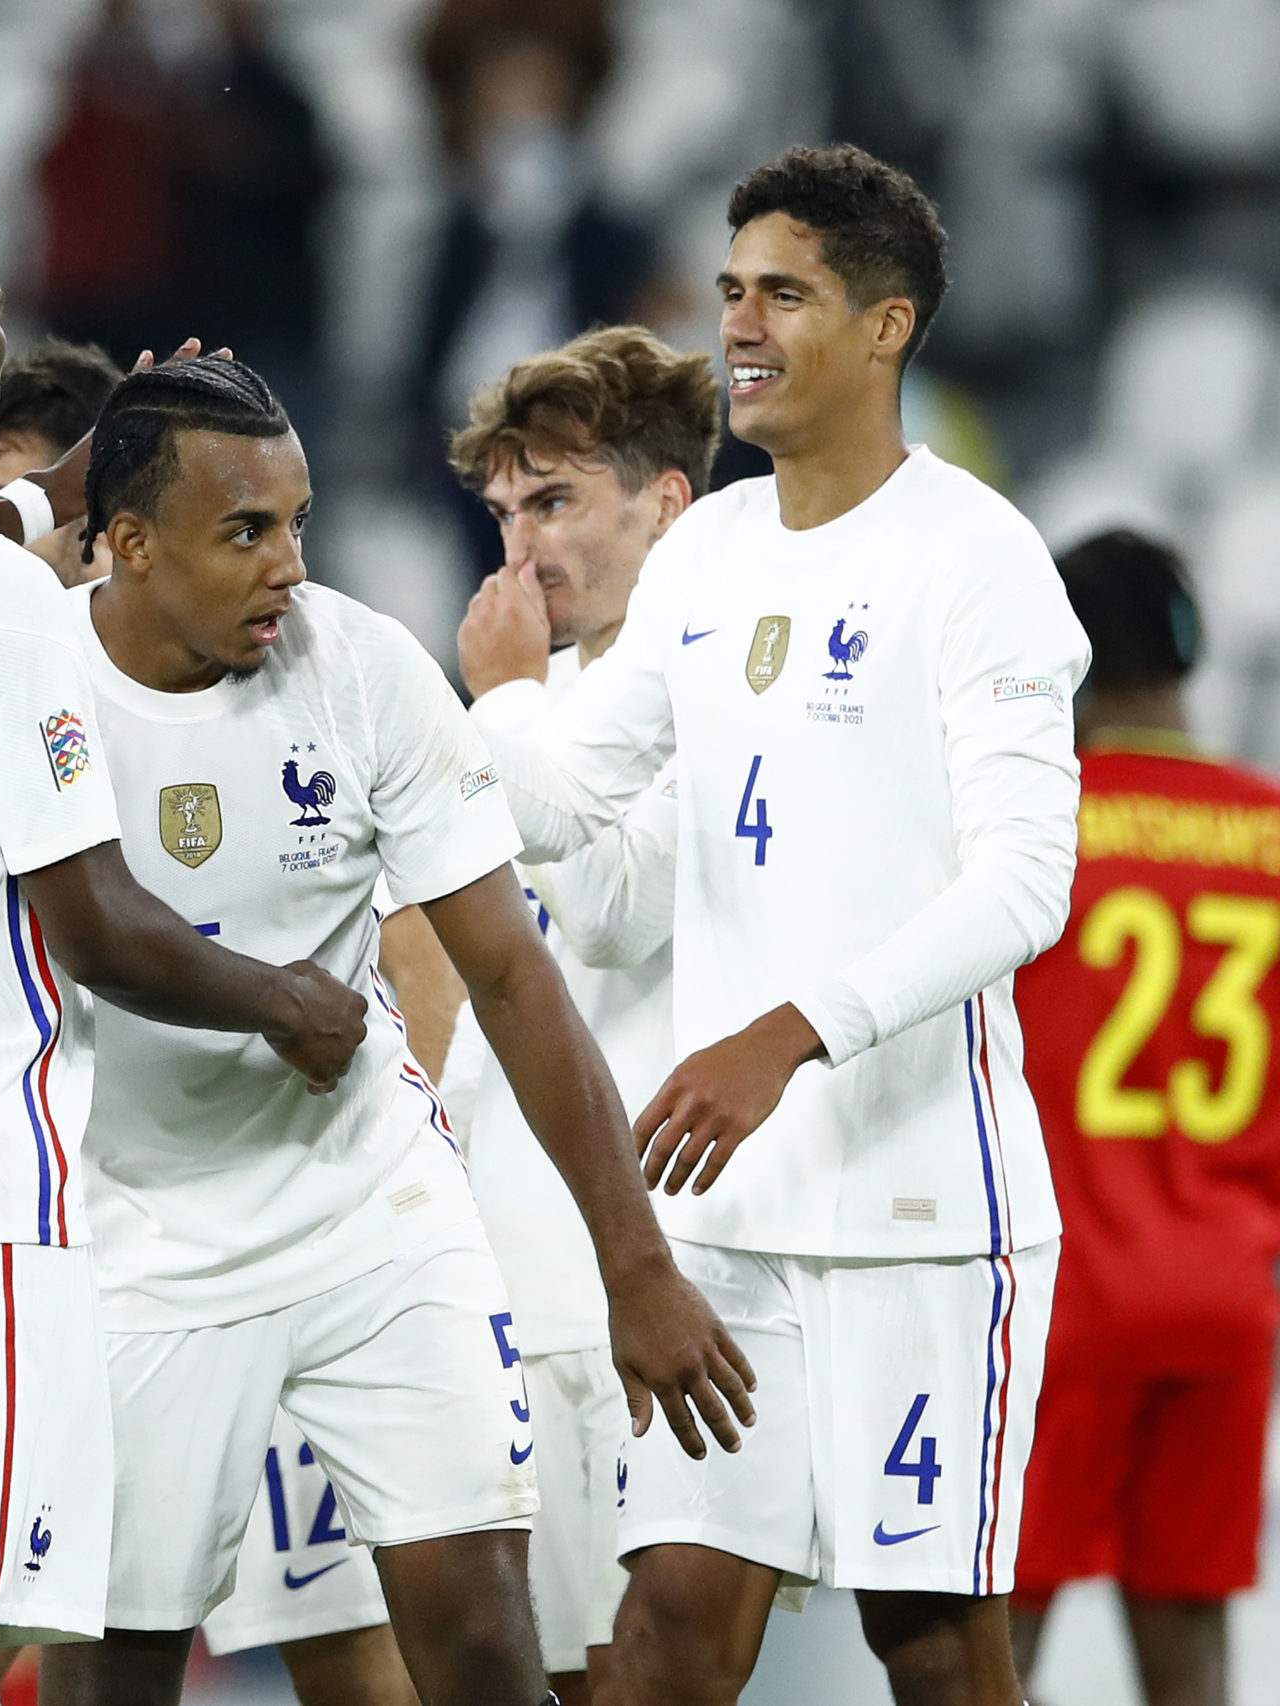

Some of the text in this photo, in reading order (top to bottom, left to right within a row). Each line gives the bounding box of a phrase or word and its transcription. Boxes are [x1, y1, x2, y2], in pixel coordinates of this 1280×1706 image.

[755, 665, 773, 676] FIFA
[844, 714, 863, 724] 2021
[179, 836, 206, 848] FIFA
[735, 755, 773, 866] 4
[1076, 886, 1280, 1144] 23
[489, 1312, 530, 1422] 5
[266, 1440, 346, 1552] 12
[884, 1394, 942, 1504] 4
